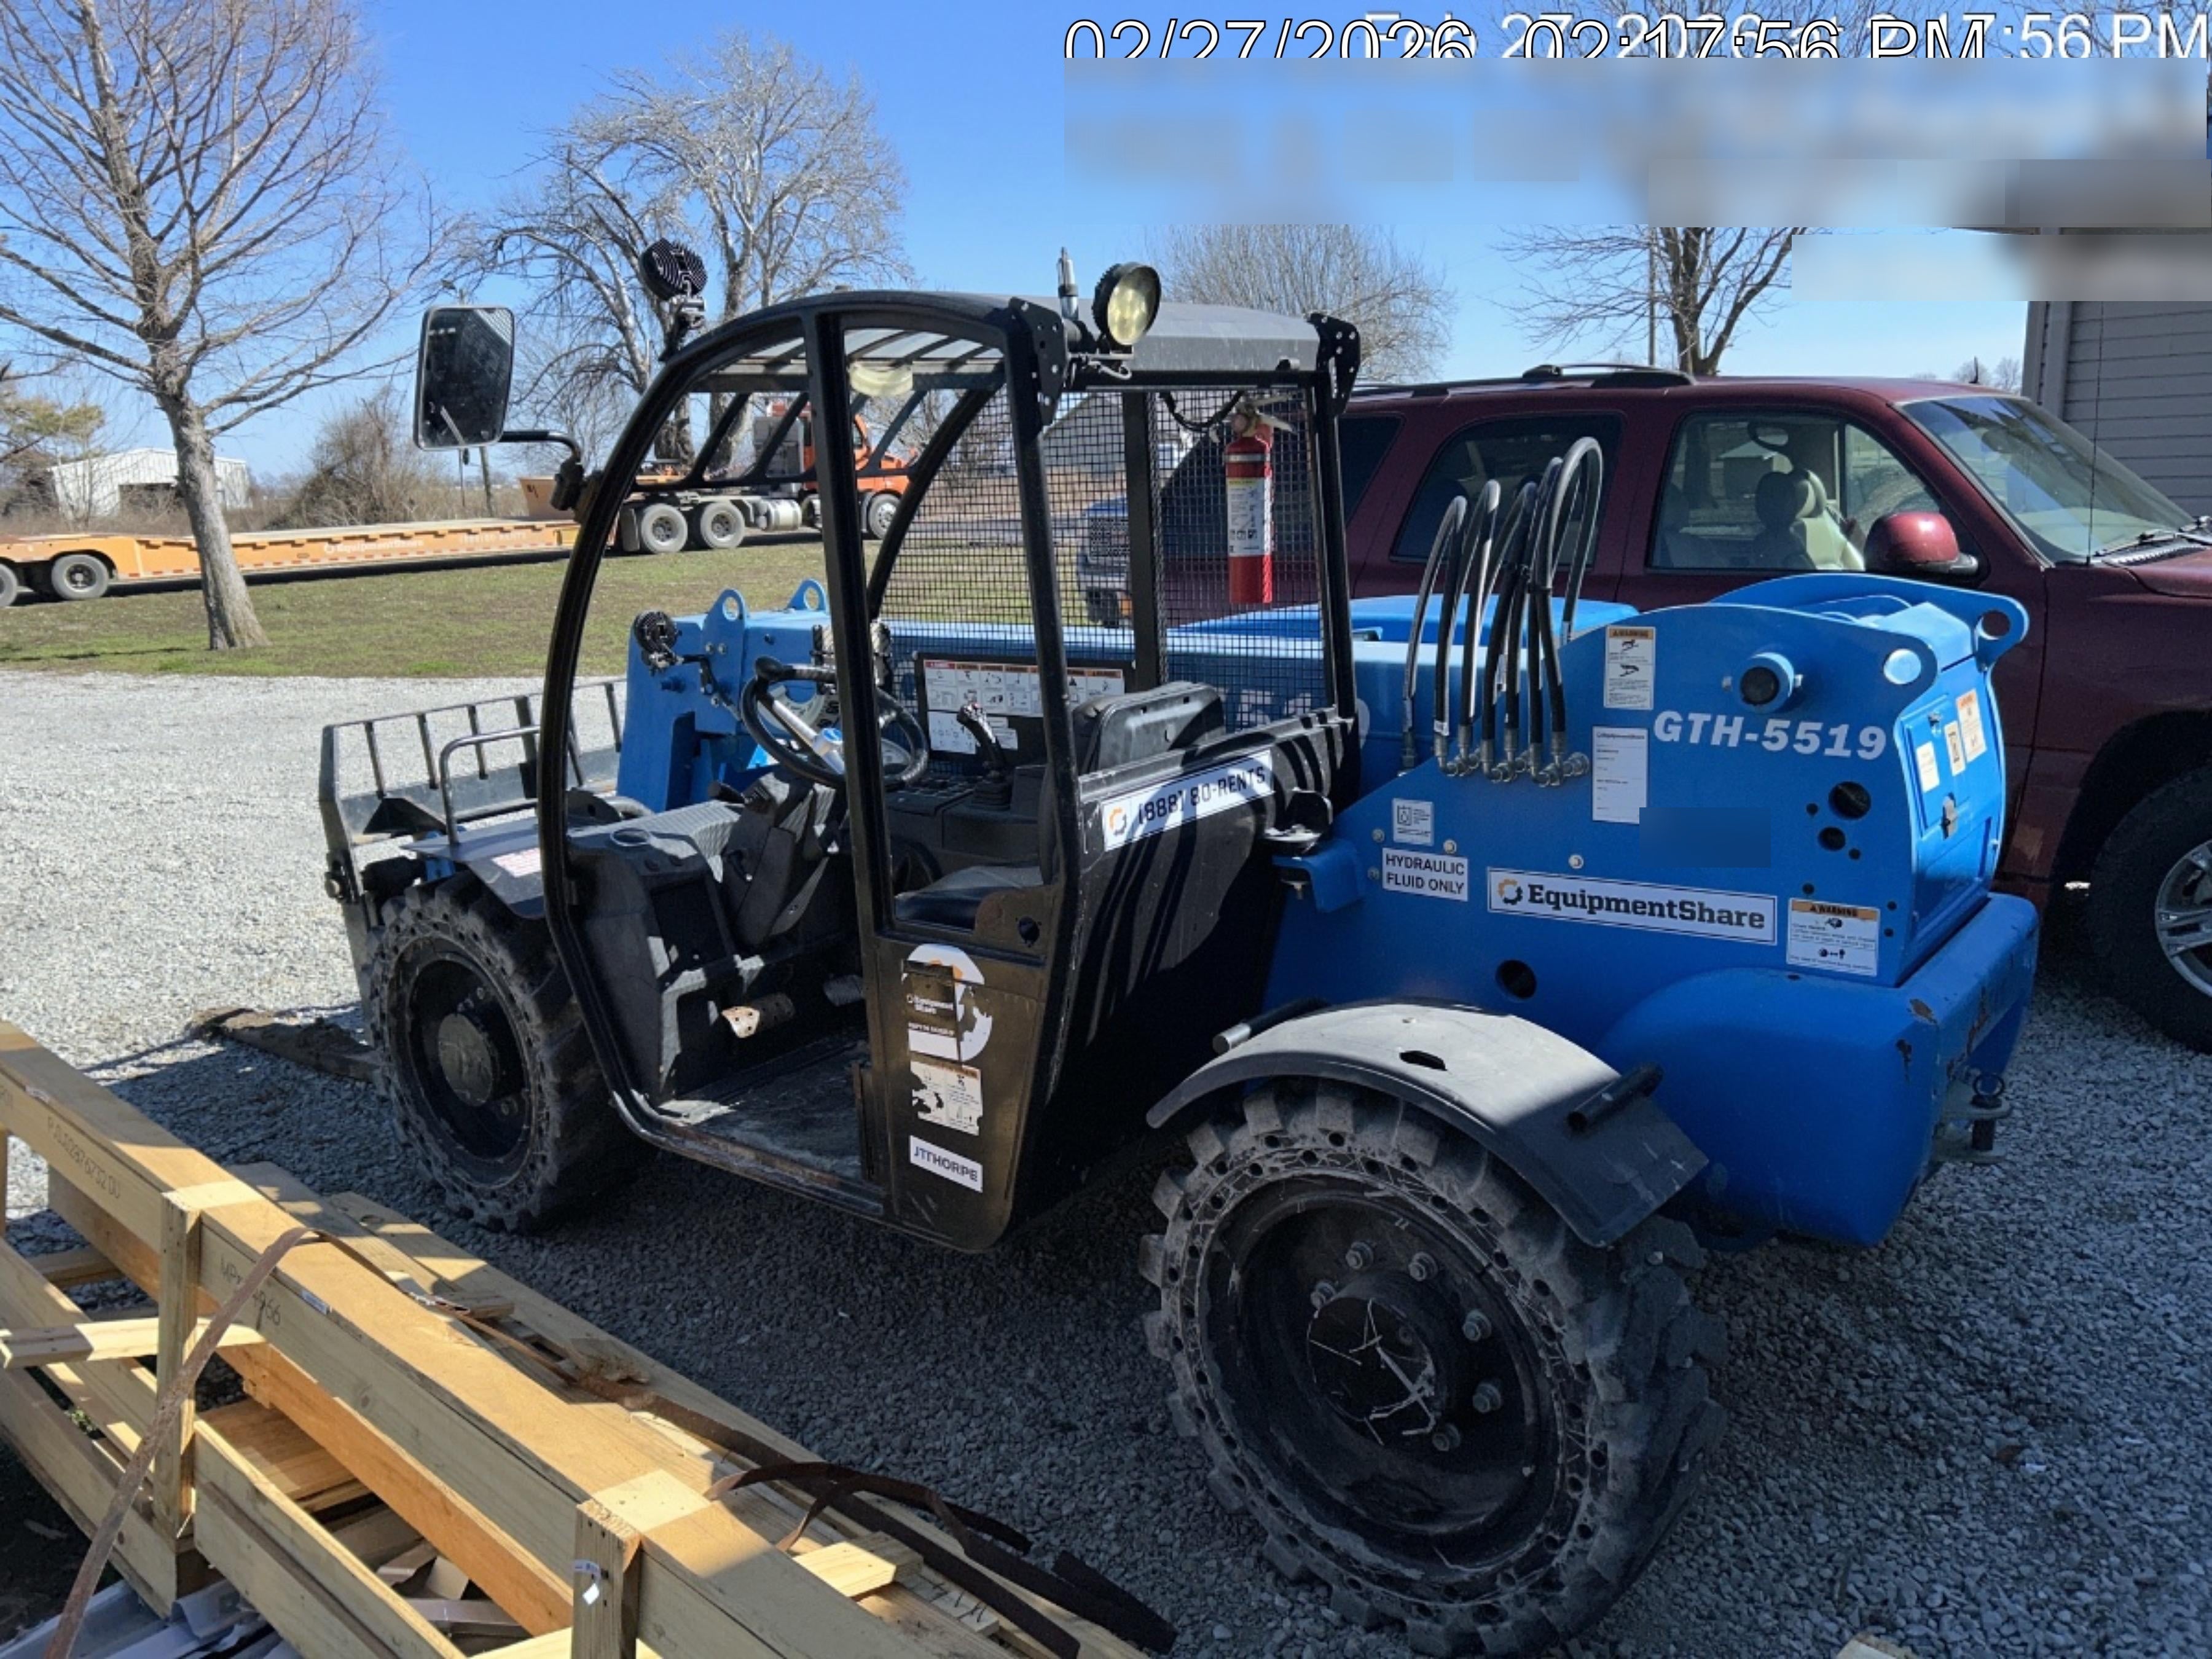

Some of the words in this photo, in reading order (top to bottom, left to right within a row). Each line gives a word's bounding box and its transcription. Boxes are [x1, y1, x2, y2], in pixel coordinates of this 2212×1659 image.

[1653, 710, 1886, 760] GTH-5519
[1190, 766, 1266, 807] 80-RENTS
[1386, 853, 1465, 876] HYDRAULIC
[1386, 872, 1425, 889] FLUID
[1428, 879, 1465, 895] ONLY
[1528, 884, 1765, 930] EquipmentShare
